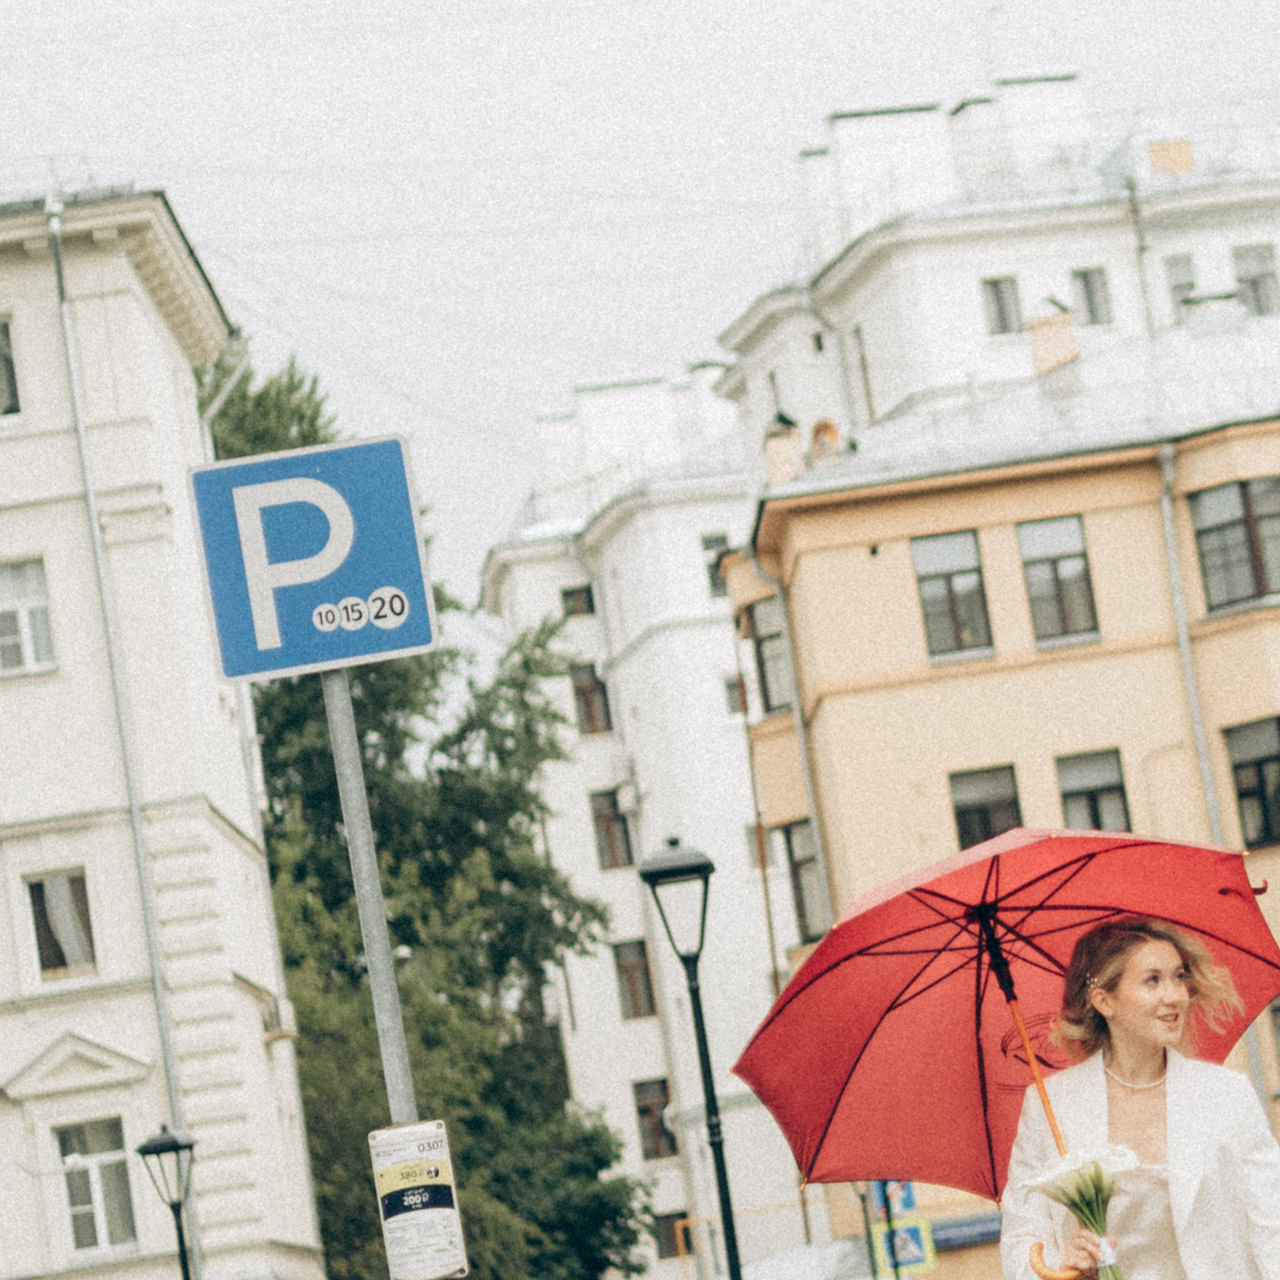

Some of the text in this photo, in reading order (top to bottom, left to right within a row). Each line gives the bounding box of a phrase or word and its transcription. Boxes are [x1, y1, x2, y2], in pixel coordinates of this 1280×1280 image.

[231, 477, 355, 651] P
[317, 594, 406, 626] 10 15 20
[418, 1140, 444, 1153] 0307
[403, 1195, 421, 1206] 200
